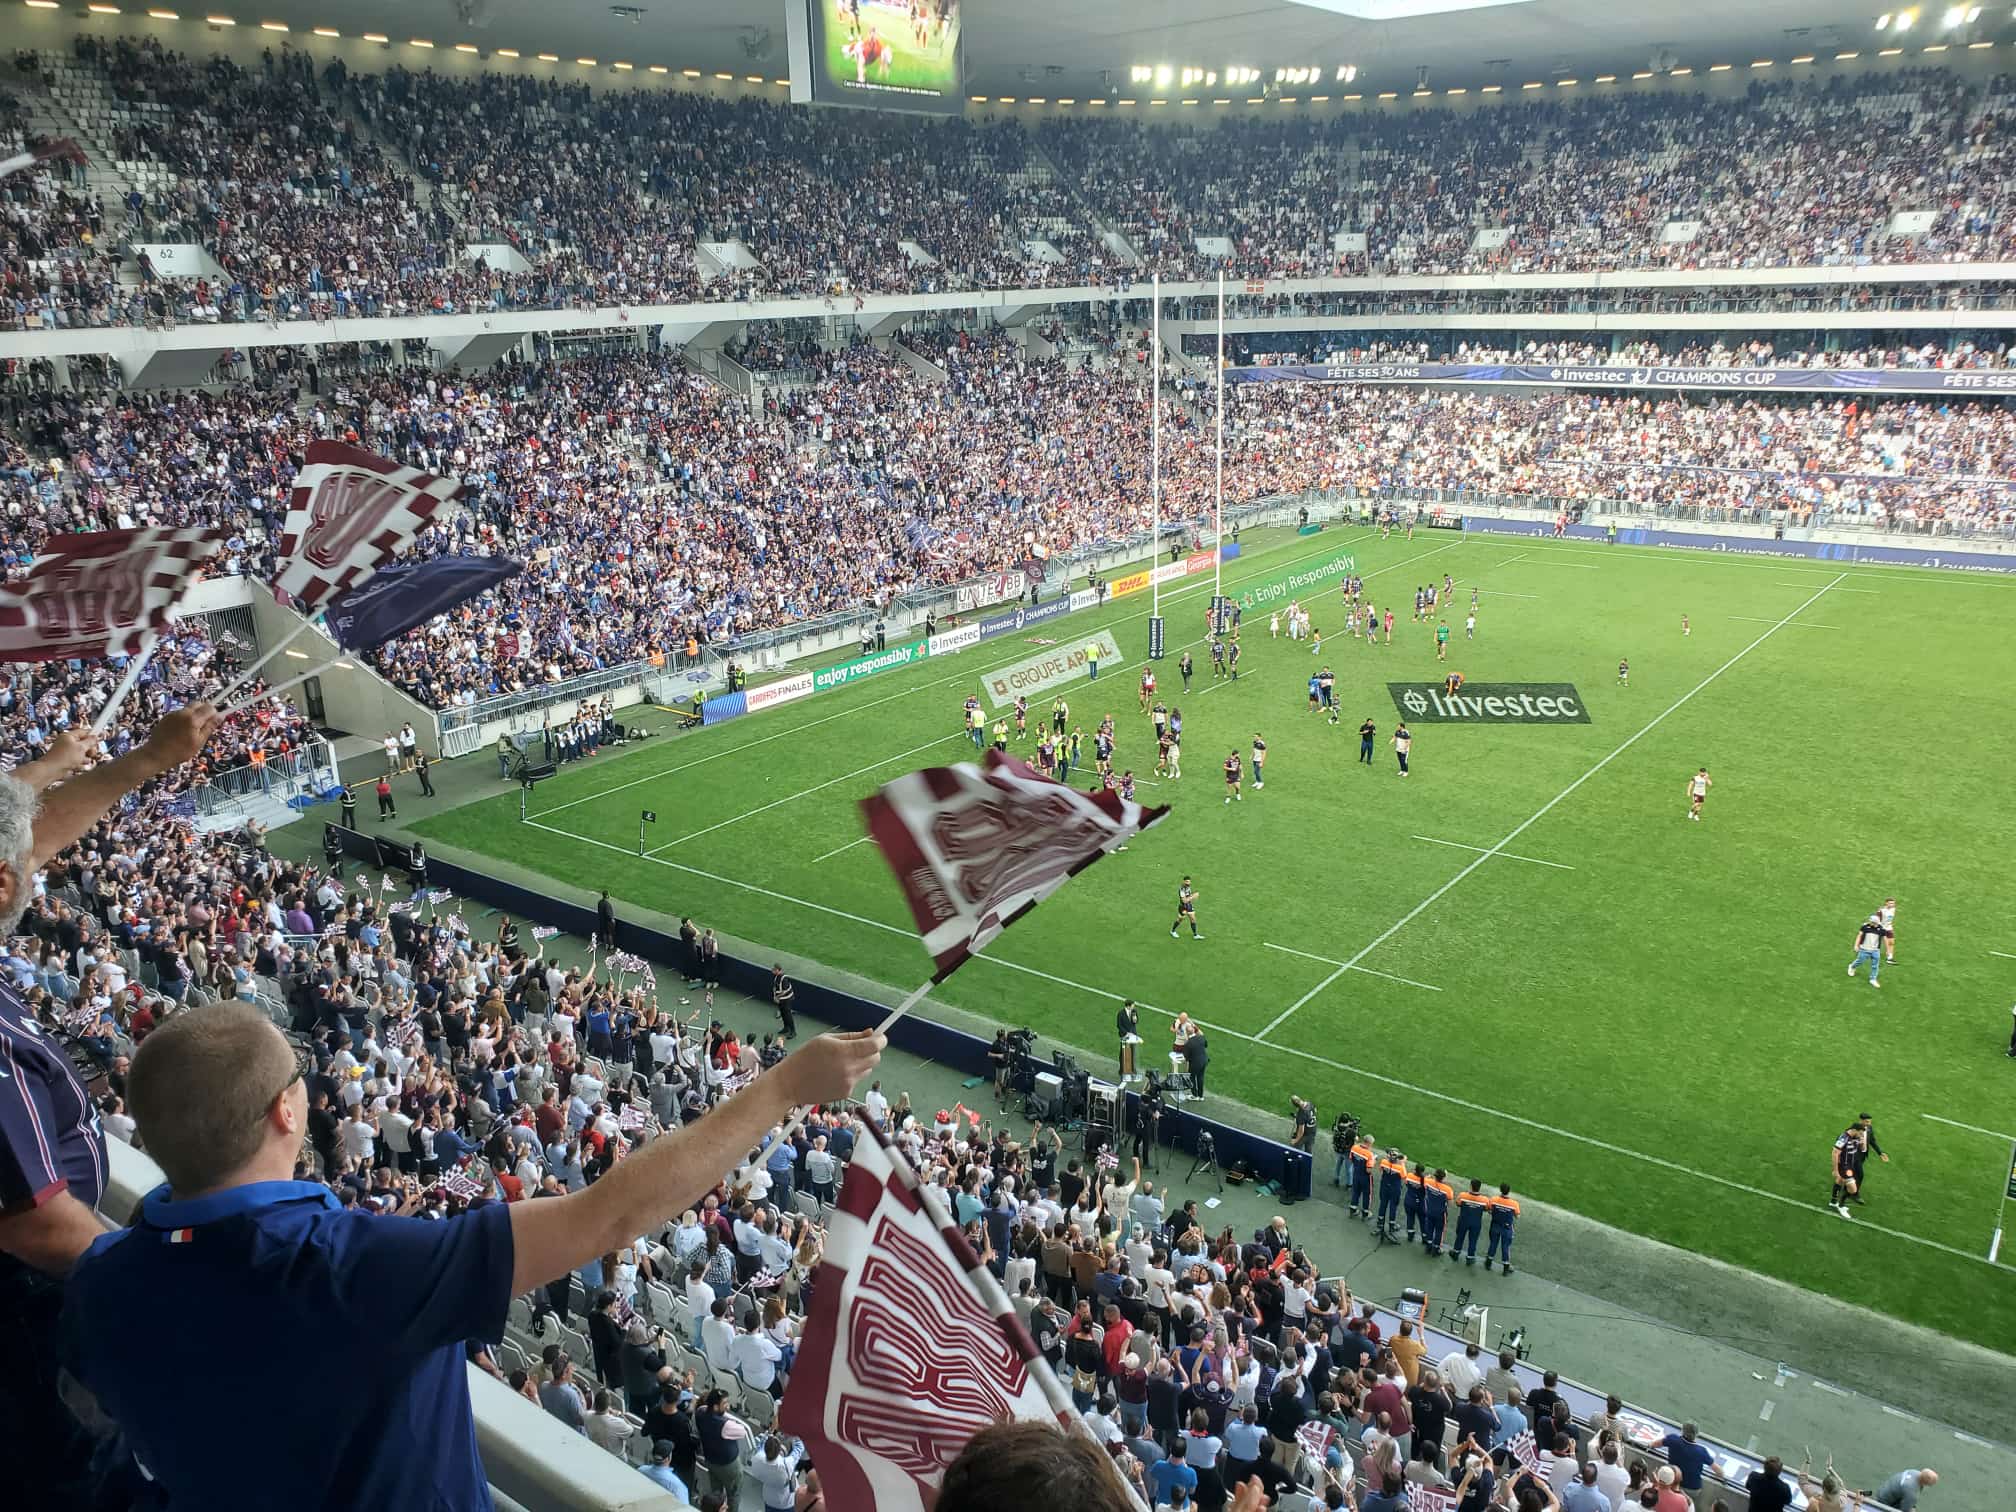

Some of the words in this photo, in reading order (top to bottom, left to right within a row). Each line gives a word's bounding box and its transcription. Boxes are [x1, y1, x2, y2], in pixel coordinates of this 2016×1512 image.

[160, 248, 173, 259] 62
[1327, 366, 1355, 378] FÊTE
[1357, 368, 1379, 378] SES
[1380, 366, 1395, 377] 30
[1395, 368, 1420, 377] ANS
[1563, 370, 1626, 382] Investec
[1656, 371, 1741, 384] CHAMPIONS
[1744, 372, 1777, 385] CUP
[1943, 373, 1984, 387] FÊTE
[1118, 576, 1143, 593] DHL
[1255, 581, 1287, 601] Enjoy
[1288, 554, 1355, 590] Responsibly
[985, 618, 1015, 634] Investec
[1025, 604, 1058, 621] CHAMPIONS
[1058, 600, 1070, 611] CUP
[939, 630, 978, 649] Investec
[816, 667, 848, 686] enjoy
[849, 647, 912, 676] responsibly
[1010, 659, 1065, 689] GROUPE
[778, 678, 812, 697] FINALES
[1427, 689, 1579, 717] Investec
